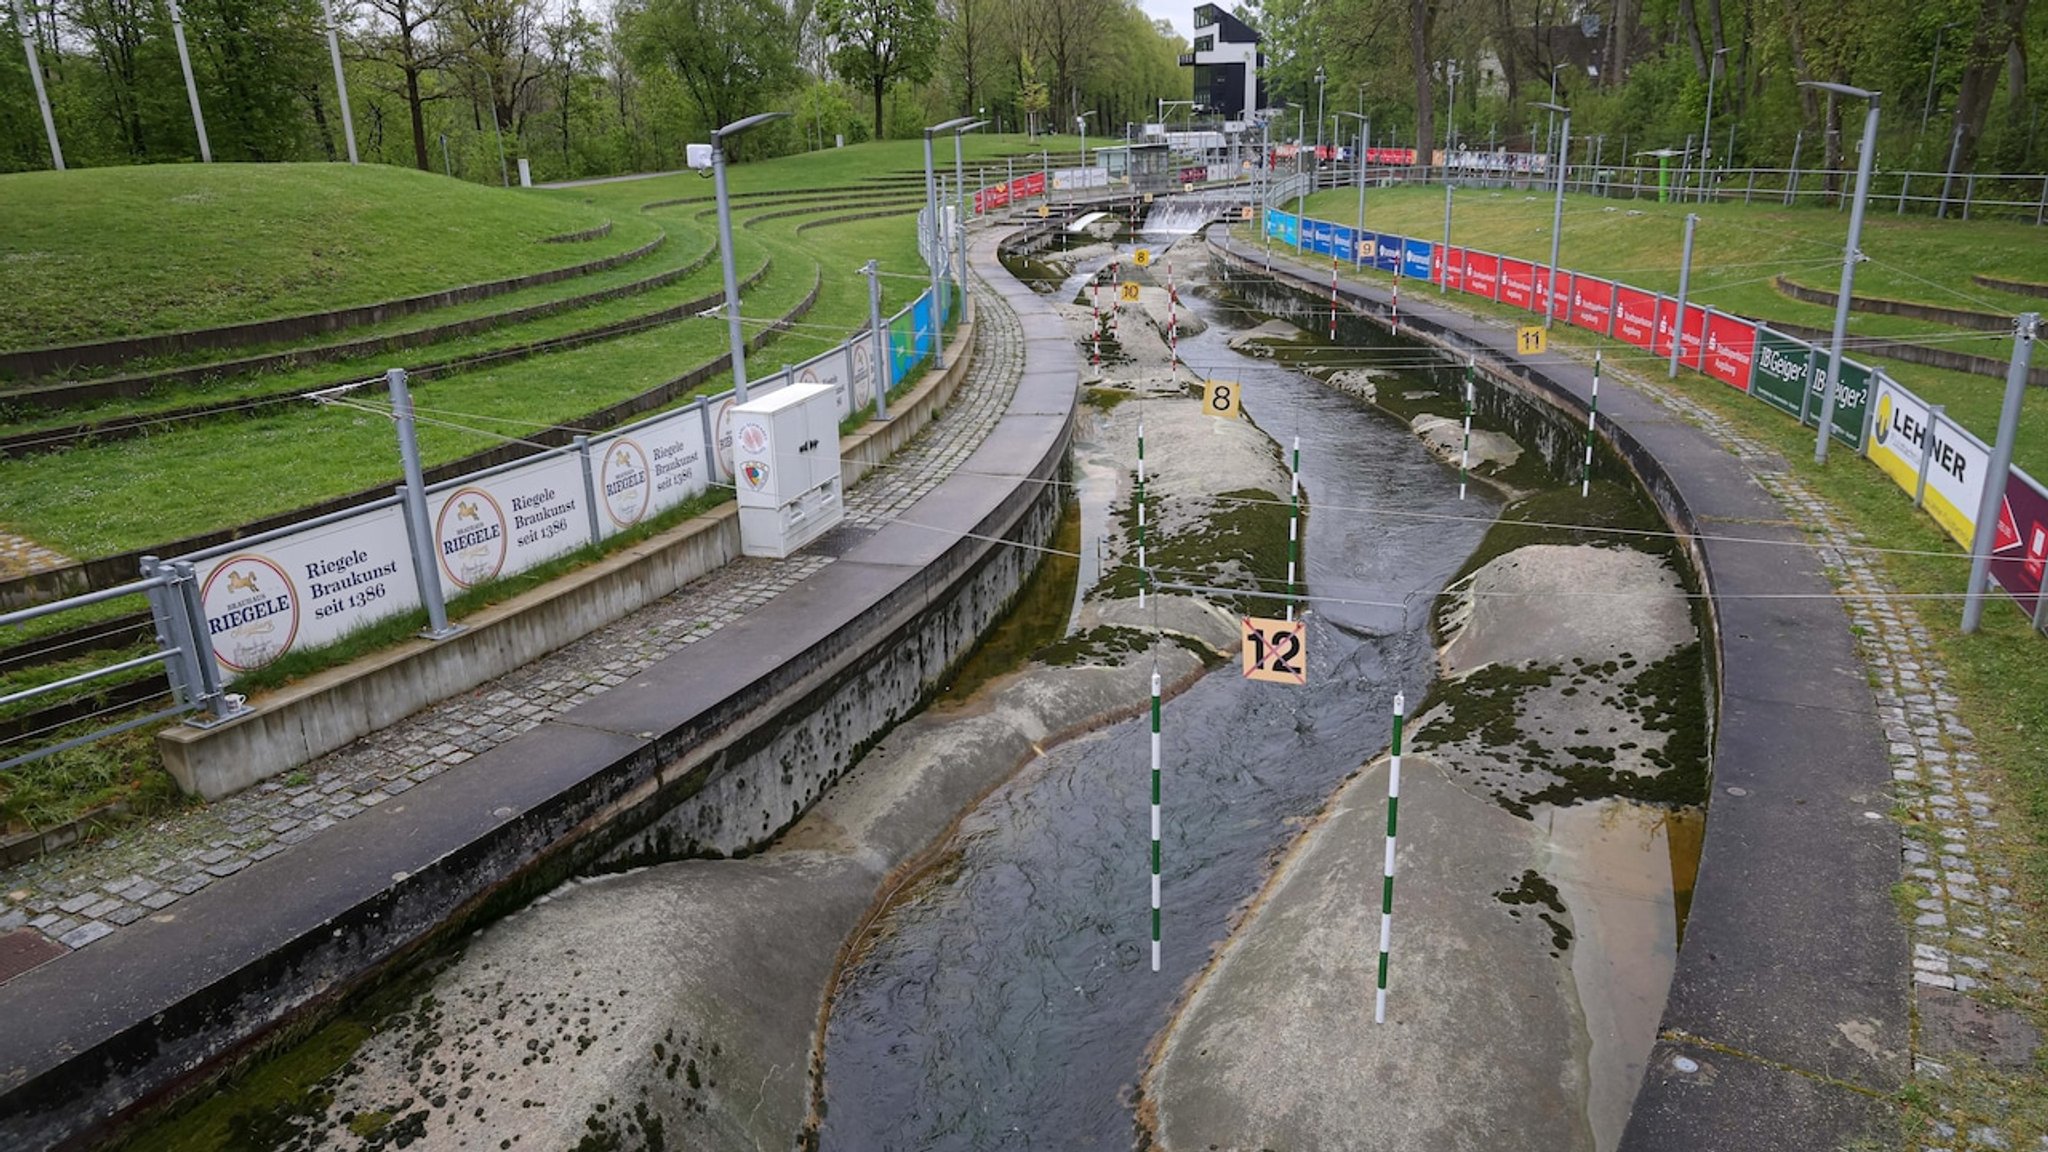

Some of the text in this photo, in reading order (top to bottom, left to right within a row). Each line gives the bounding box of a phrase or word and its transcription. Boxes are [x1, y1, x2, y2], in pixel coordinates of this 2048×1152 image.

[1136, 251, 1146, 263] 8
[1362, 243, 1372, 255] 9
[1123, 284, 1139, 299] 10
[1521, 330, 1540, 350] 11
[1212, 385, 1231, 411] 8
[653, 441, 684, 461] Riegele
[1893, 407, 1966, 483] LEHNER
[655, 451, 699, 476] Braukunst
[606, 470, 646, 497] RIEGELE
[657, 477, 672, 492] seit
[511, 488, 555, 512] Riegele
[514, 499, 576, 530] Braukunst
[443, 523, 501, 556] RIEGELE
[517, 519, 568, 547] seit 1386
[305, 549, 368, 580] Riegele
[310, 560, 398, 600] Braukunst
[208, 594, 290, 635] RIEGELE
[314, 583, 386, 620] seit 1386
[1247, 628, 1302, 675] 12
